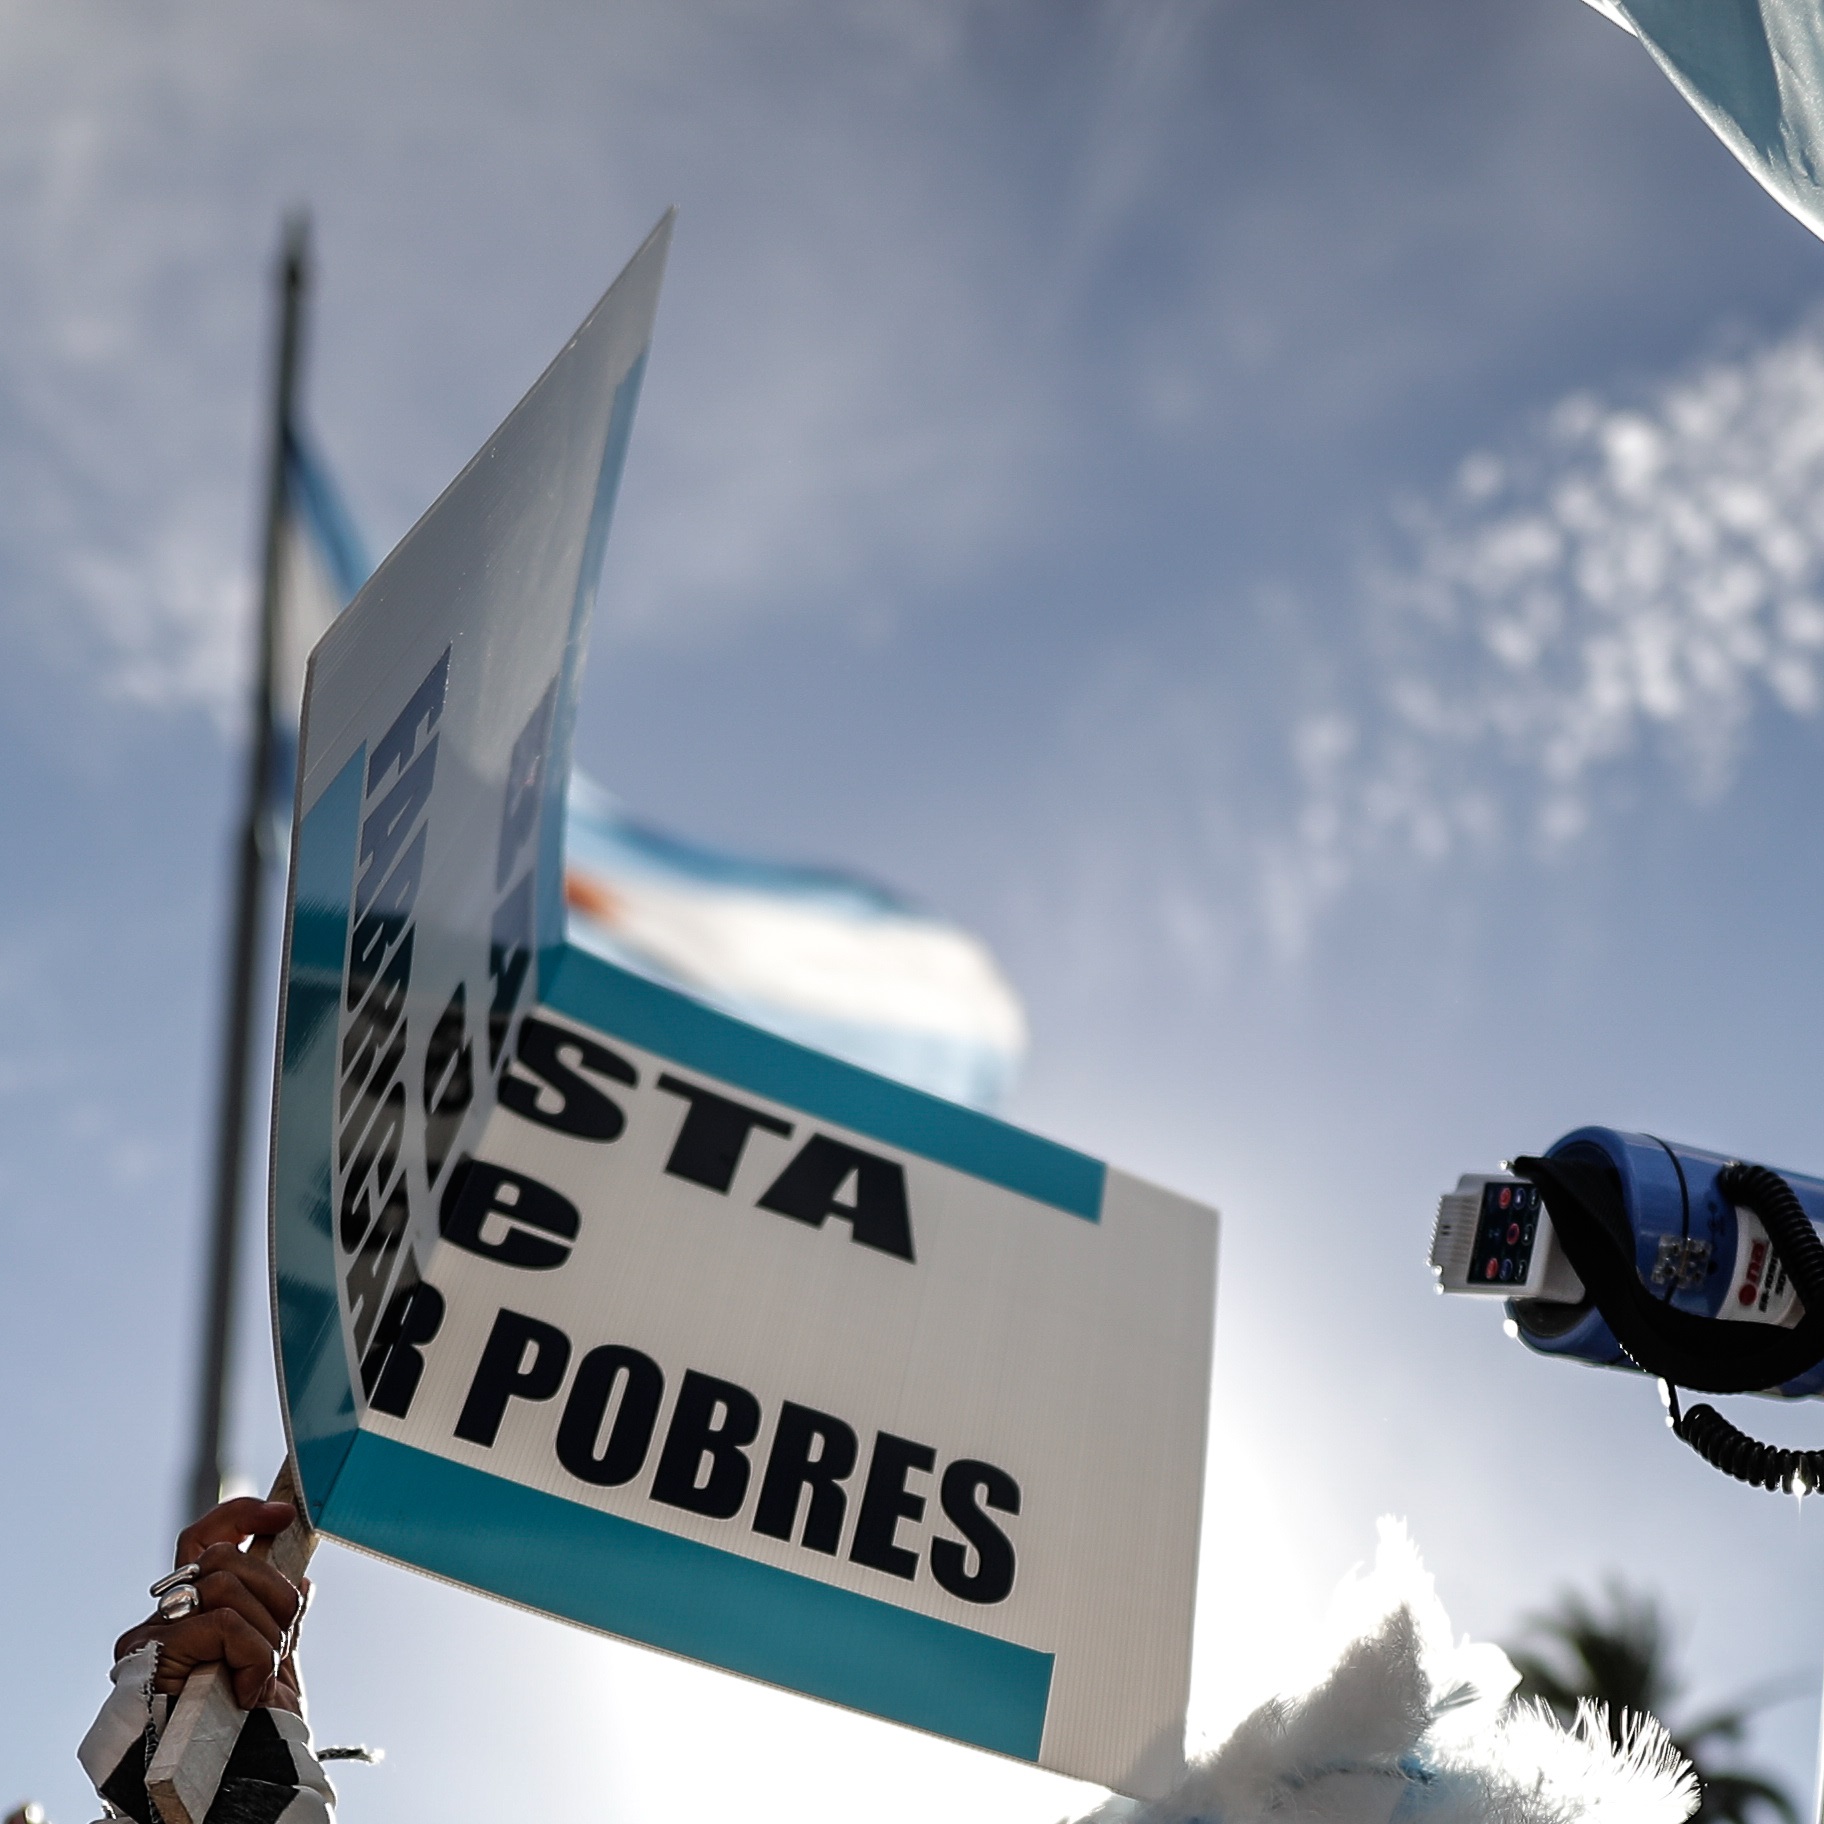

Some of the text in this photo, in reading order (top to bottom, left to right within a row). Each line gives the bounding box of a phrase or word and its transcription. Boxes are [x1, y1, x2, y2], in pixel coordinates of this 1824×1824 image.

[339, 641, 1022, 1605] FABRICAR POBRES
[423, 978, 581, 1272] de
